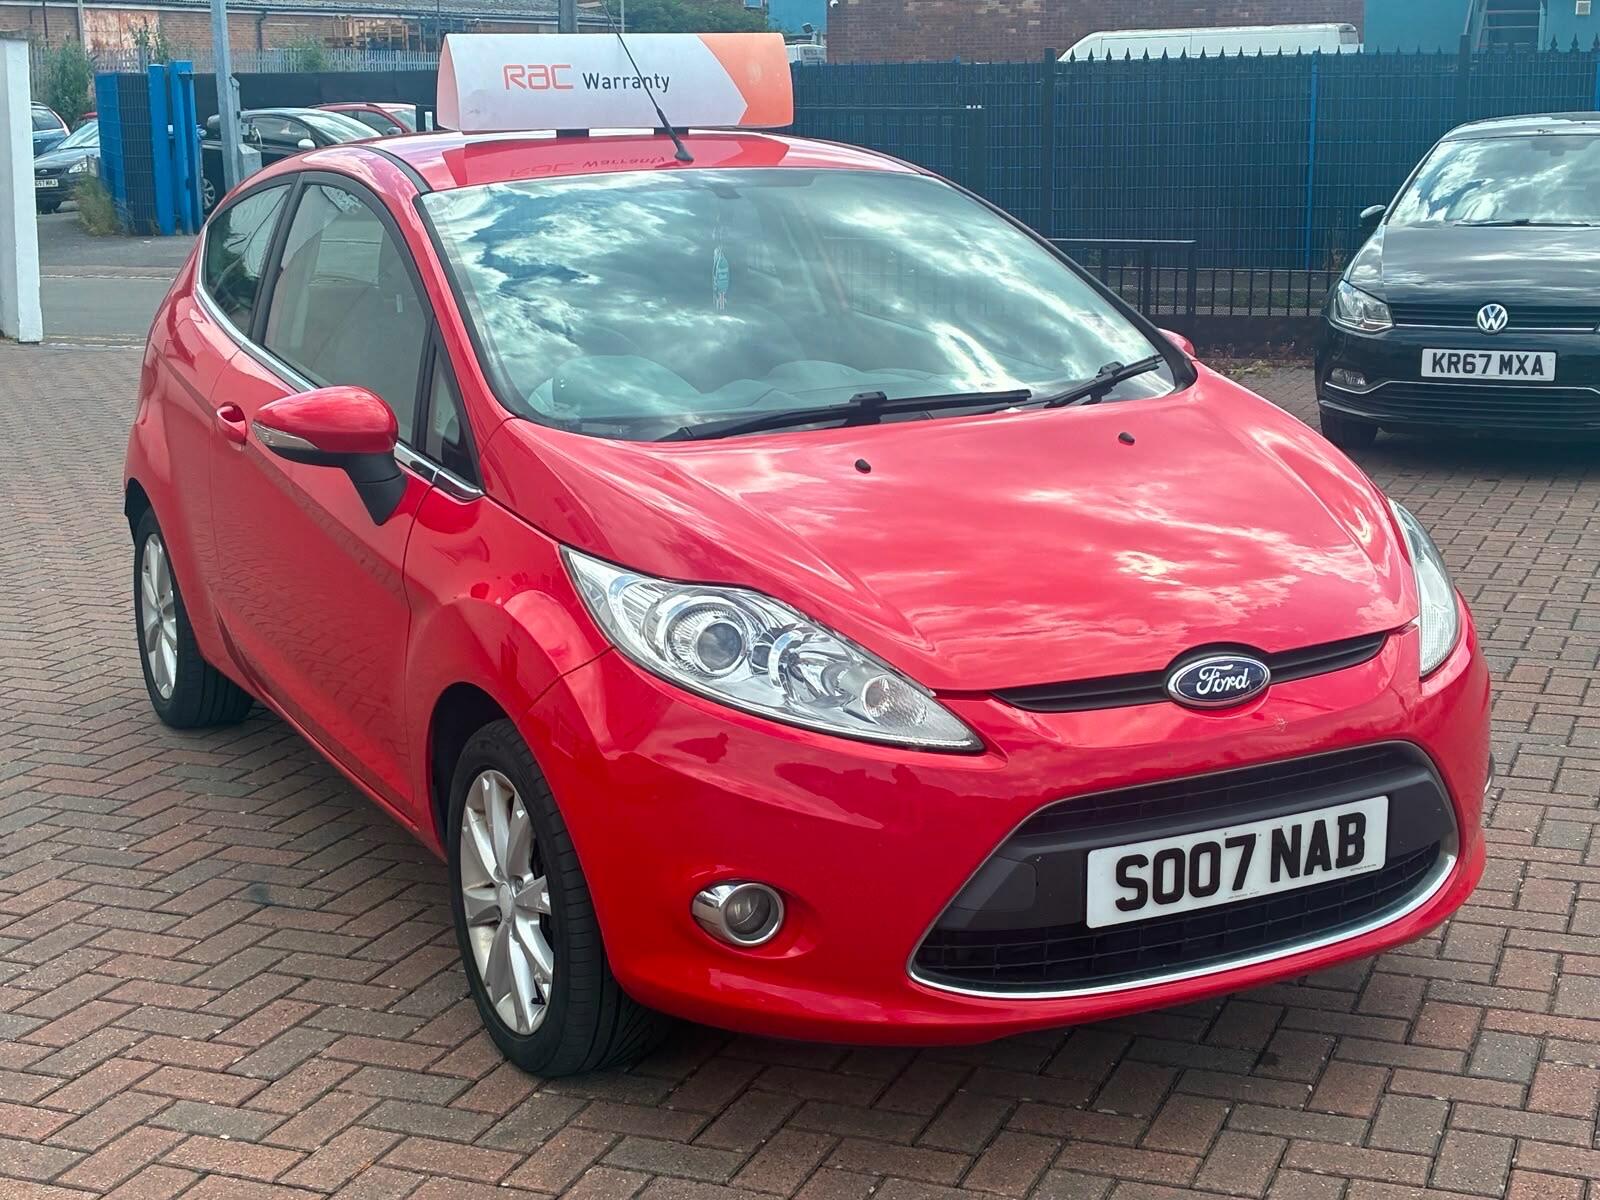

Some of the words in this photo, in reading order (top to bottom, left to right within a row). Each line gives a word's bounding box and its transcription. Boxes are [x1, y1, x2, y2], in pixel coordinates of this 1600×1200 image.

[582, 72, 670, 93] Warranty
[1431, 352, 1492, 374] KR67
[1499, 354, 1545, 376] MXA
[1196, 664, 1250, 695] Ford
[1270, 812, 1366, 883] NAB
